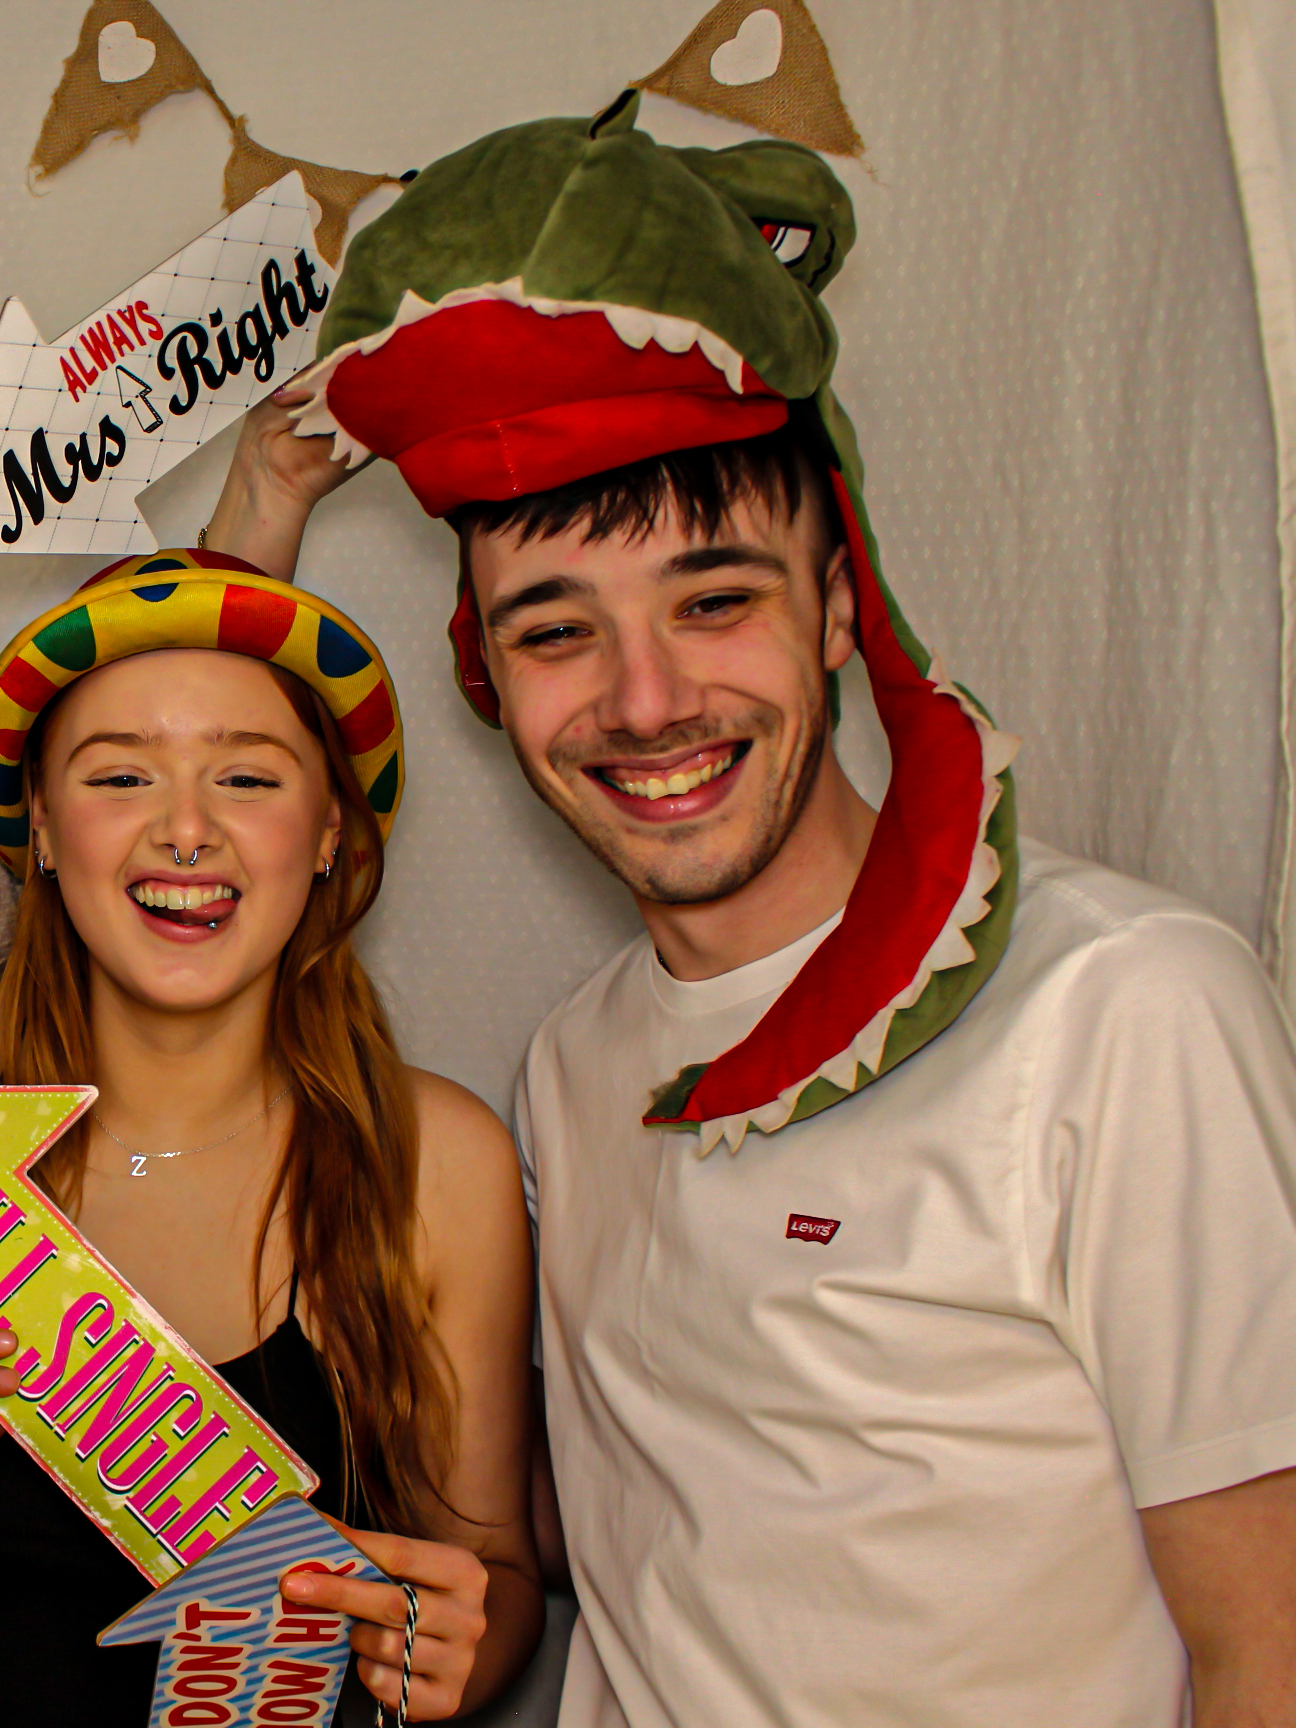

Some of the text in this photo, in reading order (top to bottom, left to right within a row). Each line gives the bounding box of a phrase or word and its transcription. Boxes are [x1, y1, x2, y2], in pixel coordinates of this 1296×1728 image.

[1, 249, 329, 544] Mrs Right
[59, 301, 164, 402] ALWAYS
[15, 1292, 280, 1567] SINGLE
[168, 1602, 252, 1727] DON'T
[255, 1660, 330, 1728] OW
